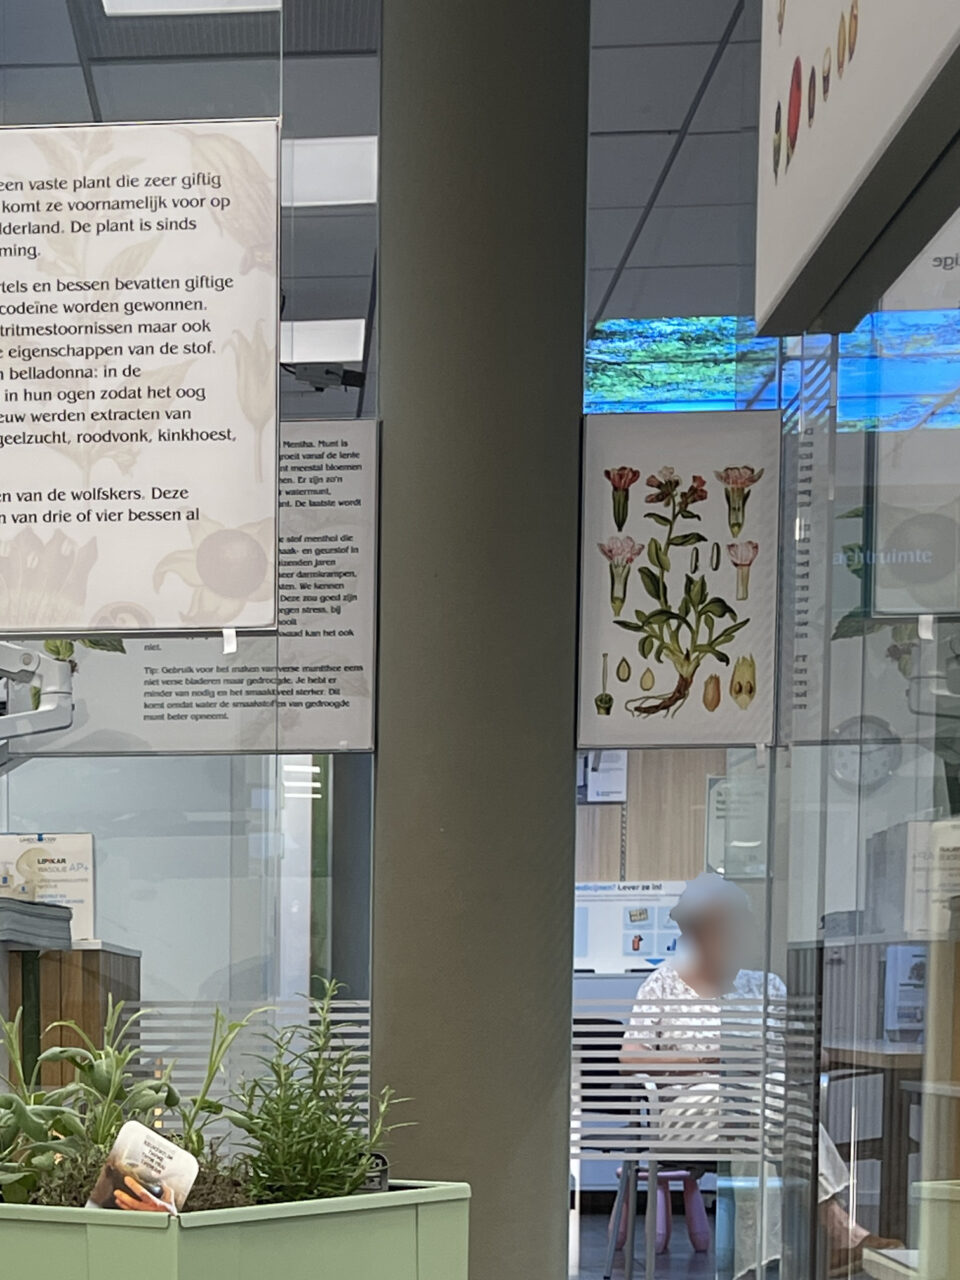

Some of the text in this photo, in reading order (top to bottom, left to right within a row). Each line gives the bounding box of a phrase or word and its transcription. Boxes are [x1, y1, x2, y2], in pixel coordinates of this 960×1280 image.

[27, 177, 68, 191] vaste
[72, 175, 112, 193] plant
[115, 174, 140, 188] die
[143, 176, 177, 187] zeer
[180, 171, 222, 190] giftig
[1, 199, 42, 213] komt
[44, 201, 63, 212] ze
[66, 195, 168, 213] voornamelijk
[171, 197, 206, 208] voor
[209, 197, 231, 211] op
[69, 219, 92, 234] De
[95, 218, 135, 236] plant
[139, 217, 152, 231] is
[155, 216, 197, 231] sinds
[31, 281, 52, 293] en
[56, 278, 110, 292] bessen
[114, 276, 180, 291] bevatten
[184, 274, 234, 293] giftige
[62, 299, 120, 314] worden
[123, 300, 207, 316] gewonnen.
[136, 322, 178, 334] maar
[181, 318, 212, 333] ook
[15, 491, 43, 502] van
[46, 487, 67, 502] de
[70, 486, 146, 503] wolfskers.
[151, 486, 190, 500] Deze
[10, 512, 38, 524] van
[41, 509, 72, 523] drie
[75, 508, 92, 523] of
[94, 508, 124, 522] vier
[127, 508, 182, 522] bessen
[185, 507, 200, 521] al
